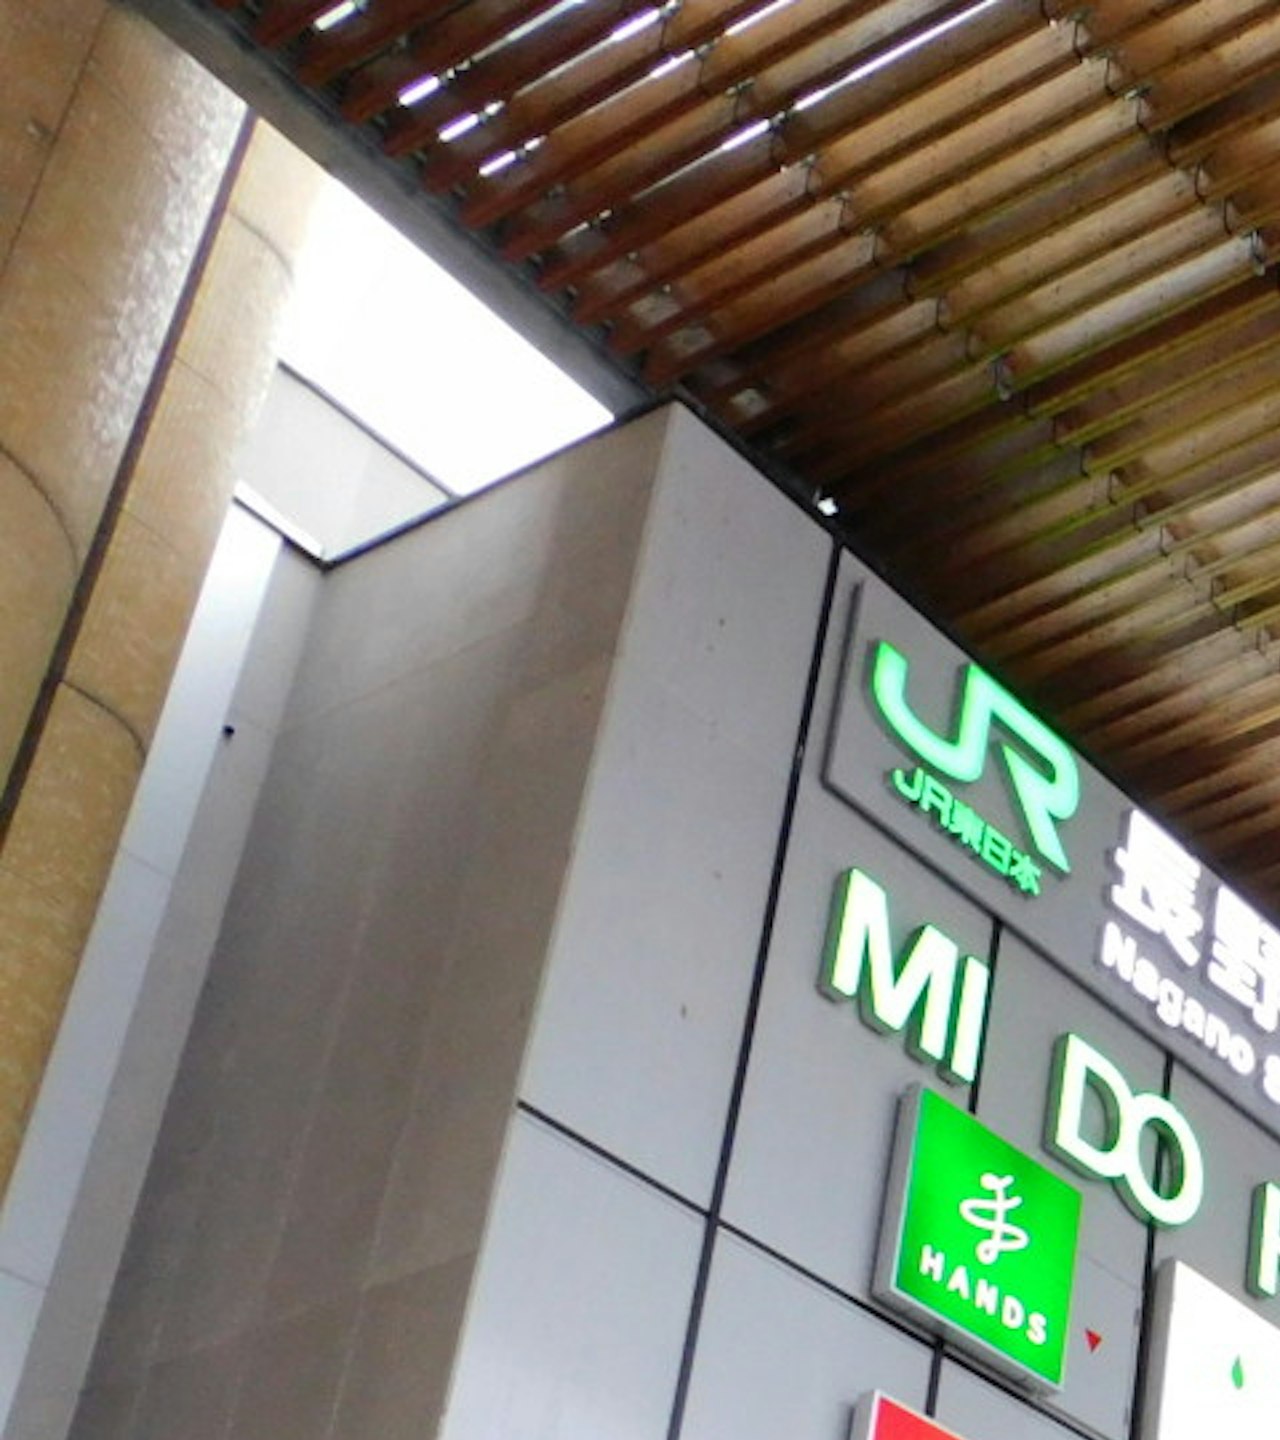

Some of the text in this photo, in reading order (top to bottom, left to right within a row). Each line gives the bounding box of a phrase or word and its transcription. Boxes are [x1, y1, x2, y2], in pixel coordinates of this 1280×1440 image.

[873, 640, 1079, 874] JR
[893, 766, 1041, 896] JR東日本
[1101, 920, 1256, 1078] Nagano
[919, 1243, 1049, 1346] HANDS
